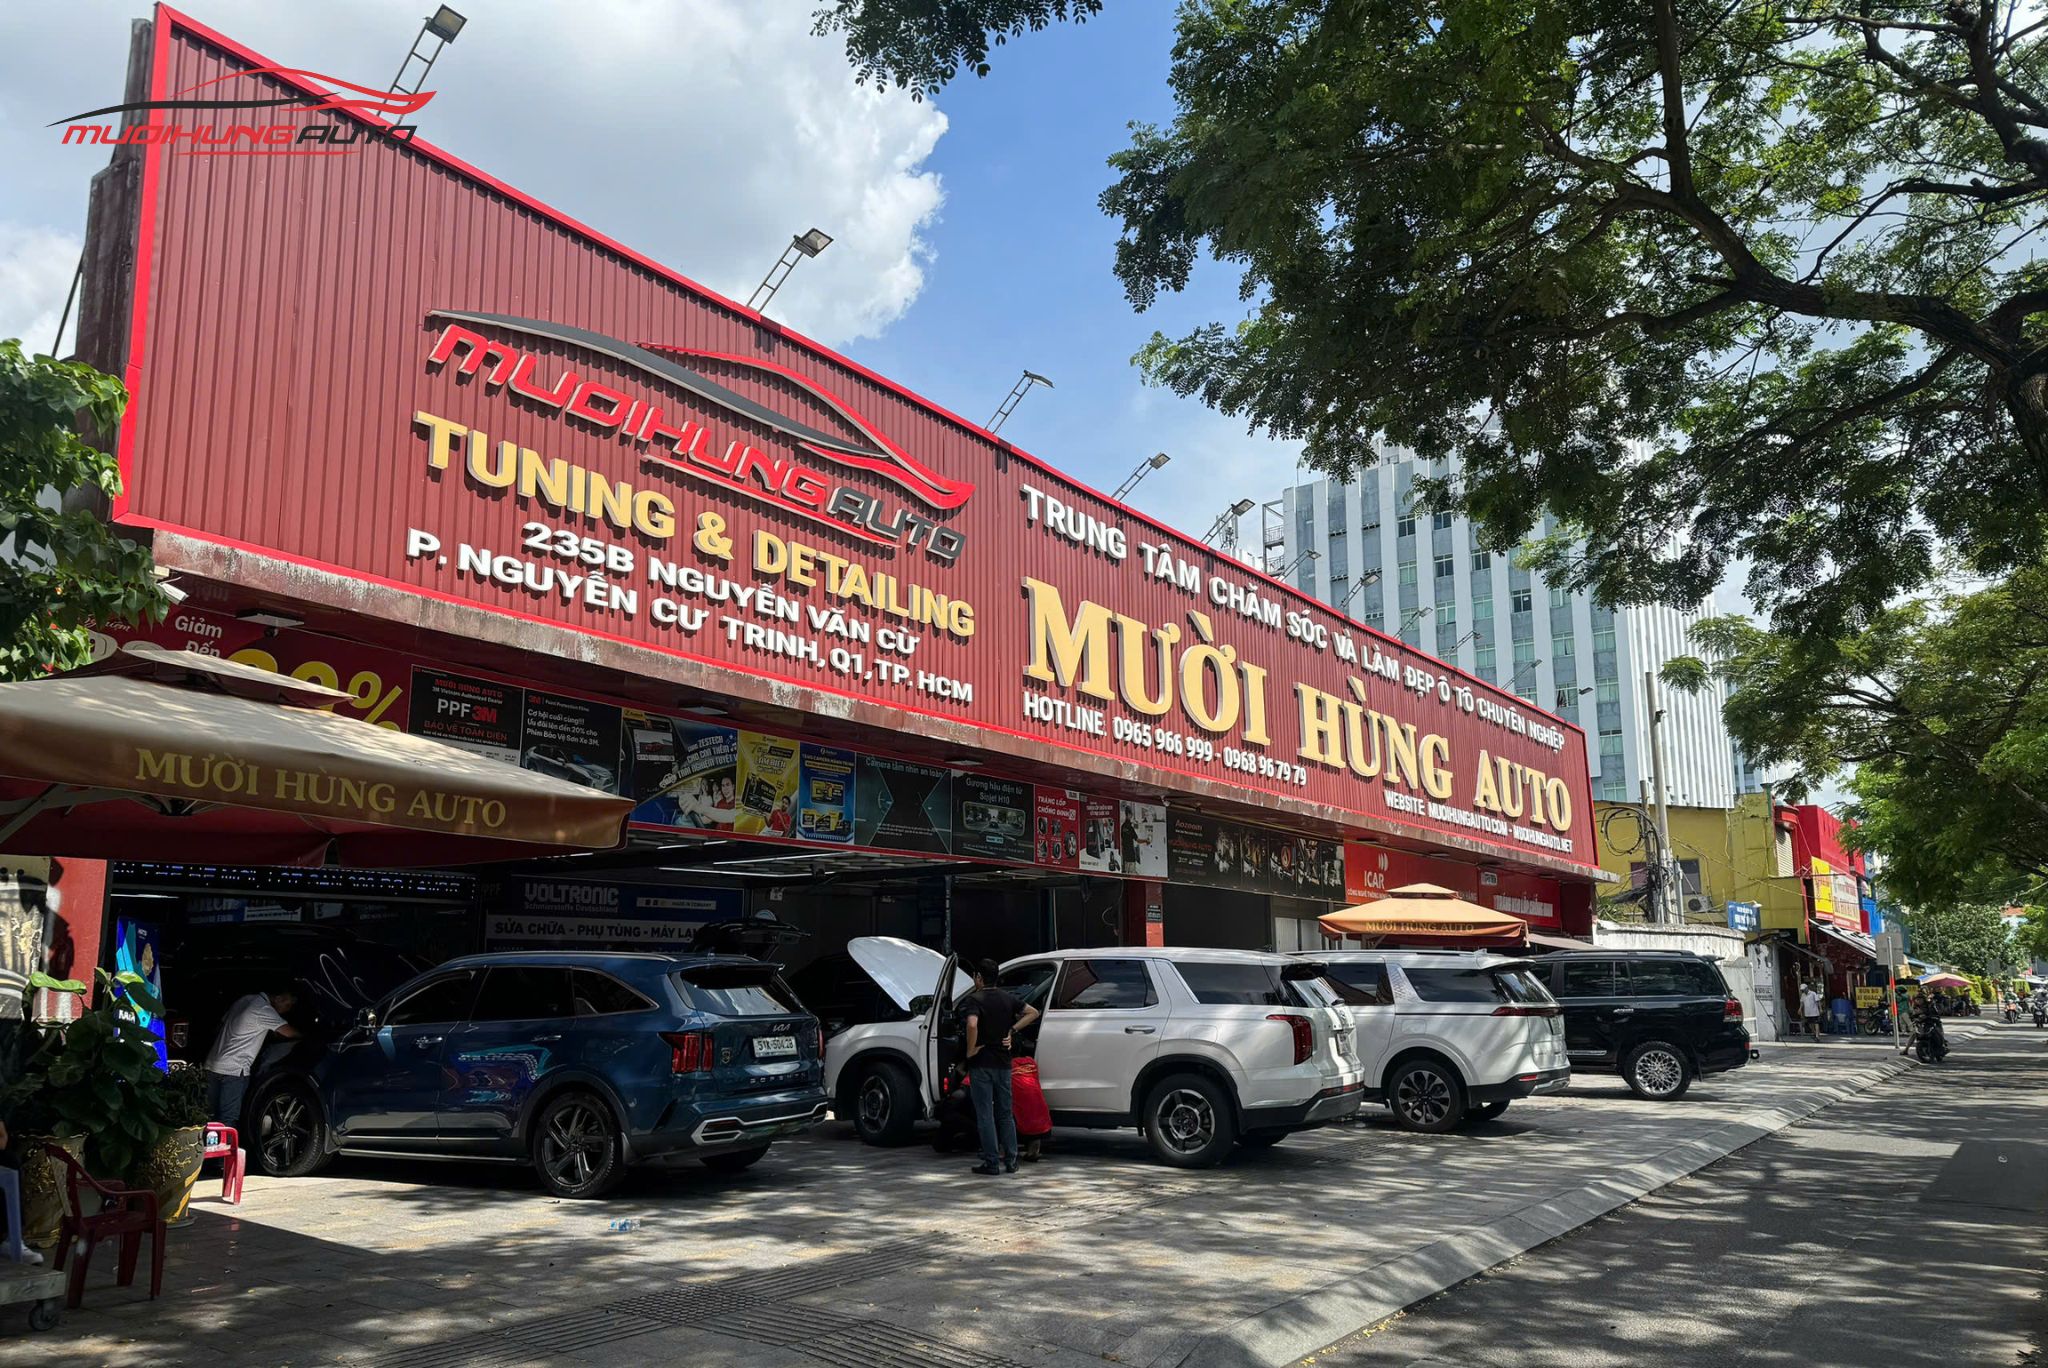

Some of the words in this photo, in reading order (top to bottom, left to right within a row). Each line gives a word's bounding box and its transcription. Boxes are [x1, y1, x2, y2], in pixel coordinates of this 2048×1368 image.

[413, 411, 676, 539] TUNING
[693, 511, 734, 560] &
[753, 529, 975, 637] DETAILING
[522, 522, 635, 572] 235B
[650, 556, 800, 623] NGUYỄN
[806, 604, 870, 643] VĂN
[876, 626, 920, 654] CỪ
[175, 614, 223, 639] Giảm
[407, 527, 447, 565] P.
[457, 543, 638, 615] NGUYỄN
[651, 598, 710, 632] CƯ
[720, 615, 826, 668] TRINH,
[917, 669, 973, 702] HCM
[1020, 484, 1127, 560] TRUNG
[1139, 542, 1201, 594] TÂM
[1208, 576, 1282, 629] CHĂM
[1286, 608, 1328, 649] SÓC
[1331, 629, 1358, 663] VÀ
[1361, 644, 1400, 682] LÀM
[1403, 664, 1435, 698] ĐẸP
[1437, 675, 1451, 702] Ô
[1453, 686, 1475, 713] TÔ
[1476, 697, 1526, 735] CHUYÊN
[1528, 719, 1566, 754] NGHIỆP
[437, 698, 471, 718] PPF
[472, 704, 498, 725] 3M
[527, 693, 541, 705] 3M
[1022, 576, 1270, 746] MƯỜI
[1295, 675, 1453, 799] HÙNG
[1473, 749, 1572, 832] AUTO
[572, 726, 586, 735] 20%
[586, 728, 598, 737] cho
[698, 735, 724, 747] ZESTECH
[1023, 691, 1107, 737] HOTLINE:
[1112, 716, 1152, 747] 0965
[1155, 728, 1183, 755] 966
[1186, 736, 1213, 763] 999
[1223, 746, 1257, 774] 0968
[134, 747, 259, 797] MƯỜI
[274, 767, 396, 815] HÙNG
[407, 788, 507, 830] AUTO
[1384, 789, 1426, 815] WEBSITE
[1175, 819, 1204, 832] Aozoom
[1363, 870, 1385, 890] ICAR
[524, 882, 620, 906] VOLTRONIC
[495, 917, 524, 935] SỬA
[528, 918, 566, 936] CHỮA
[577, 925, 604, 940] PHỤ
[607, 923, 641, 938] TÙNG
[651, 925, 676, 938] MÁY
[1403, 920, 1437, 933] HÙNG
[1441, 923, 1475, 934] AUTO
